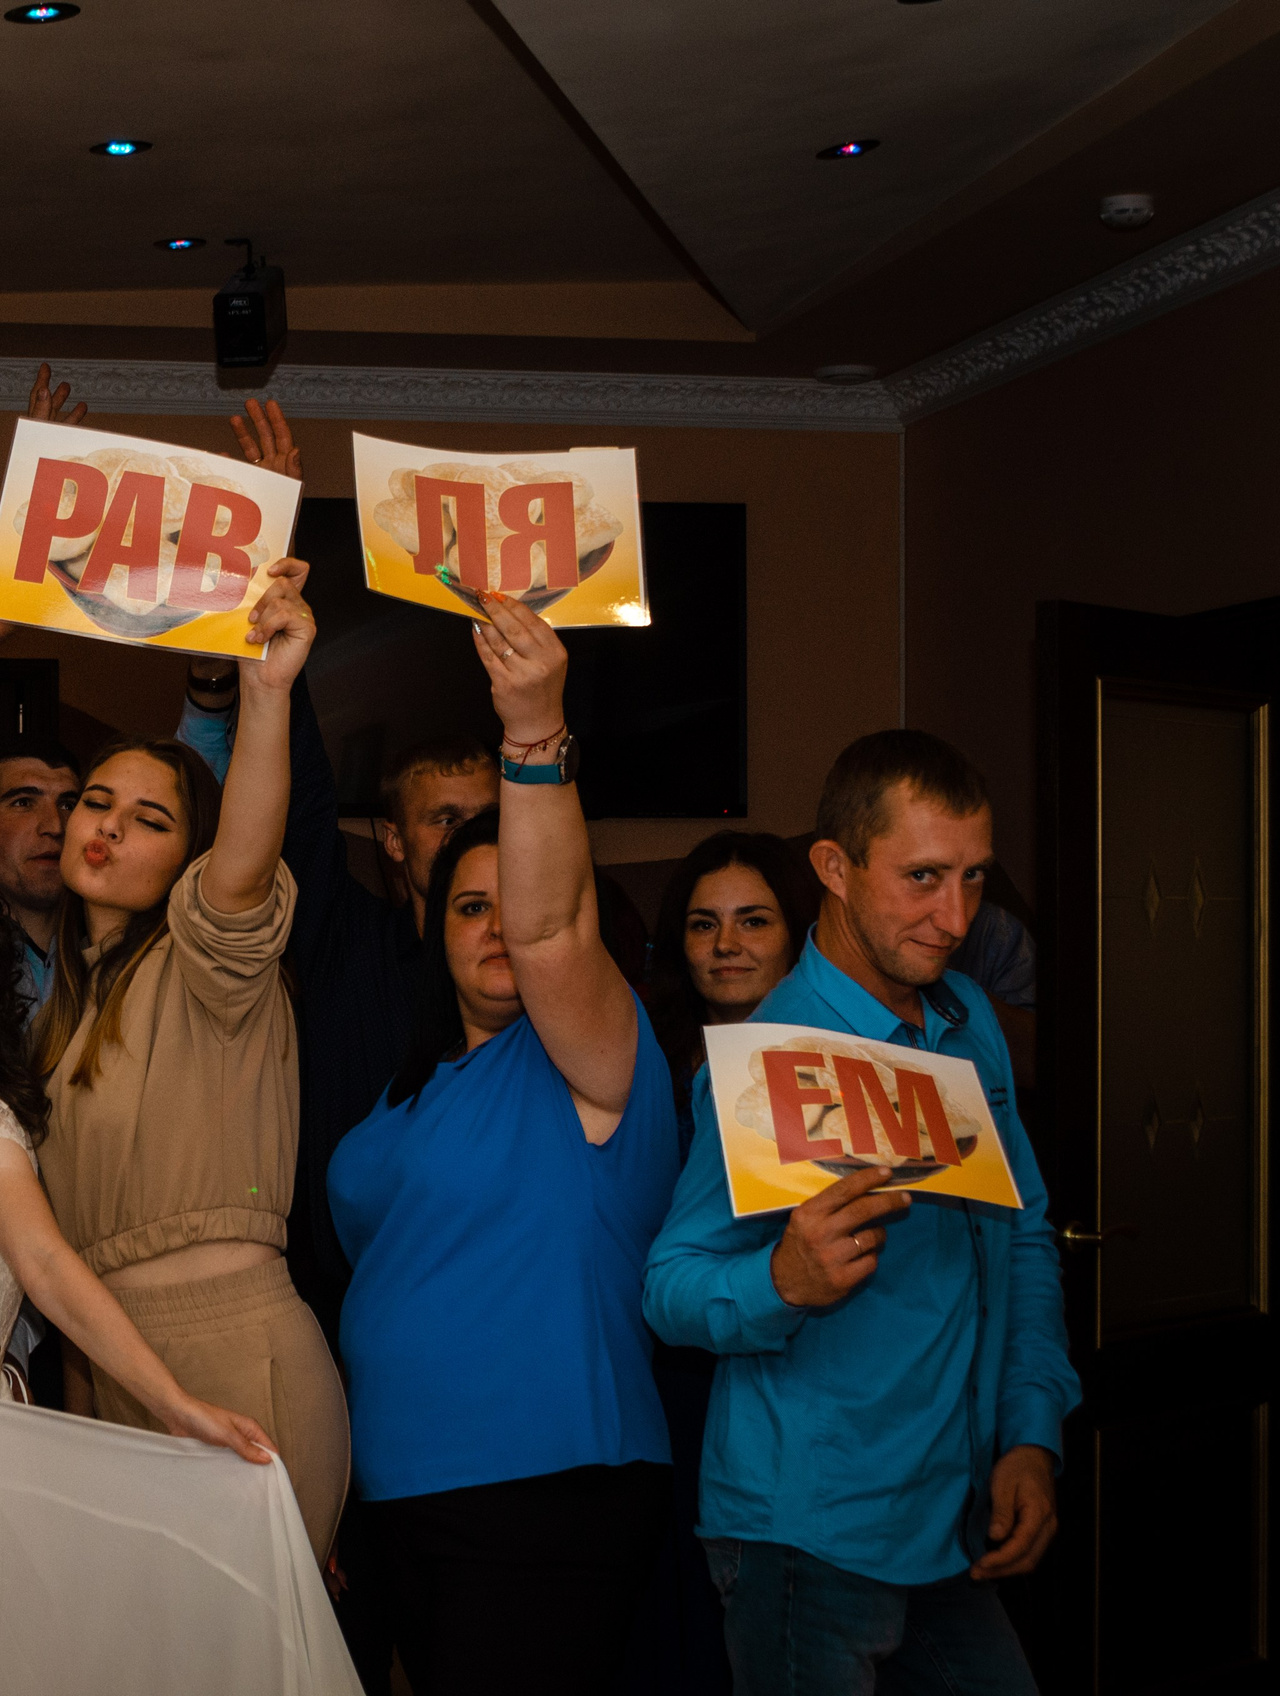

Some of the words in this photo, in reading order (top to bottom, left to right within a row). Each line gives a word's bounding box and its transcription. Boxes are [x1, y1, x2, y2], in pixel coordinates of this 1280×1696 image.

[13, 457, 262, 612] РАВ
[412, 475, 579, 591] ЛЯ
[761, 1051, 962, 1167] ЕМ
